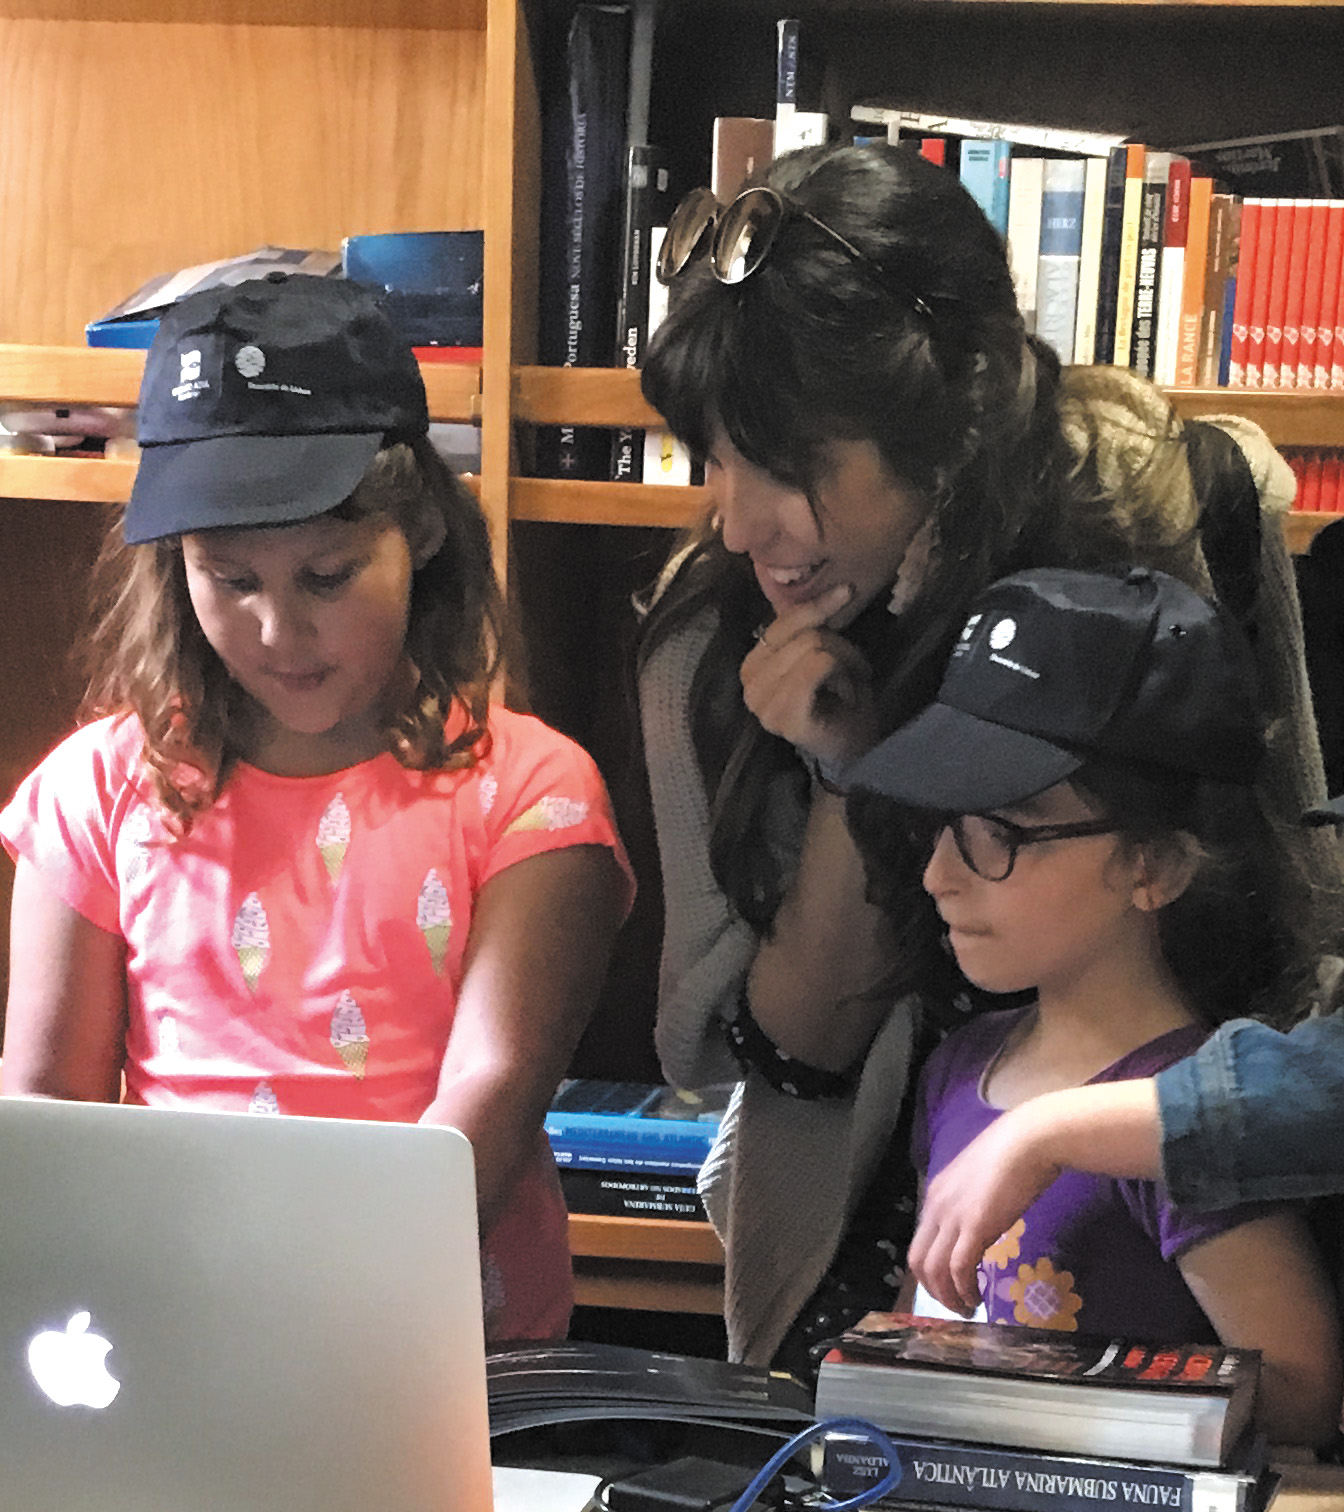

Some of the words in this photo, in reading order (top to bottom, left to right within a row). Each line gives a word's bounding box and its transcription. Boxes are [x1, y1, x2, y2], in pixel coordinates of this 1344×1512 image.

[1182, 313, 1197, 363] RANCE
[1180, 366, 1195, 385] LA
[912, 1460, 1009, 1492] ATLÂNTICA
[1015, 1471, 1117, 1501] SUBMARINA
[1123, 1484, 1181, 1507] FAUNA
